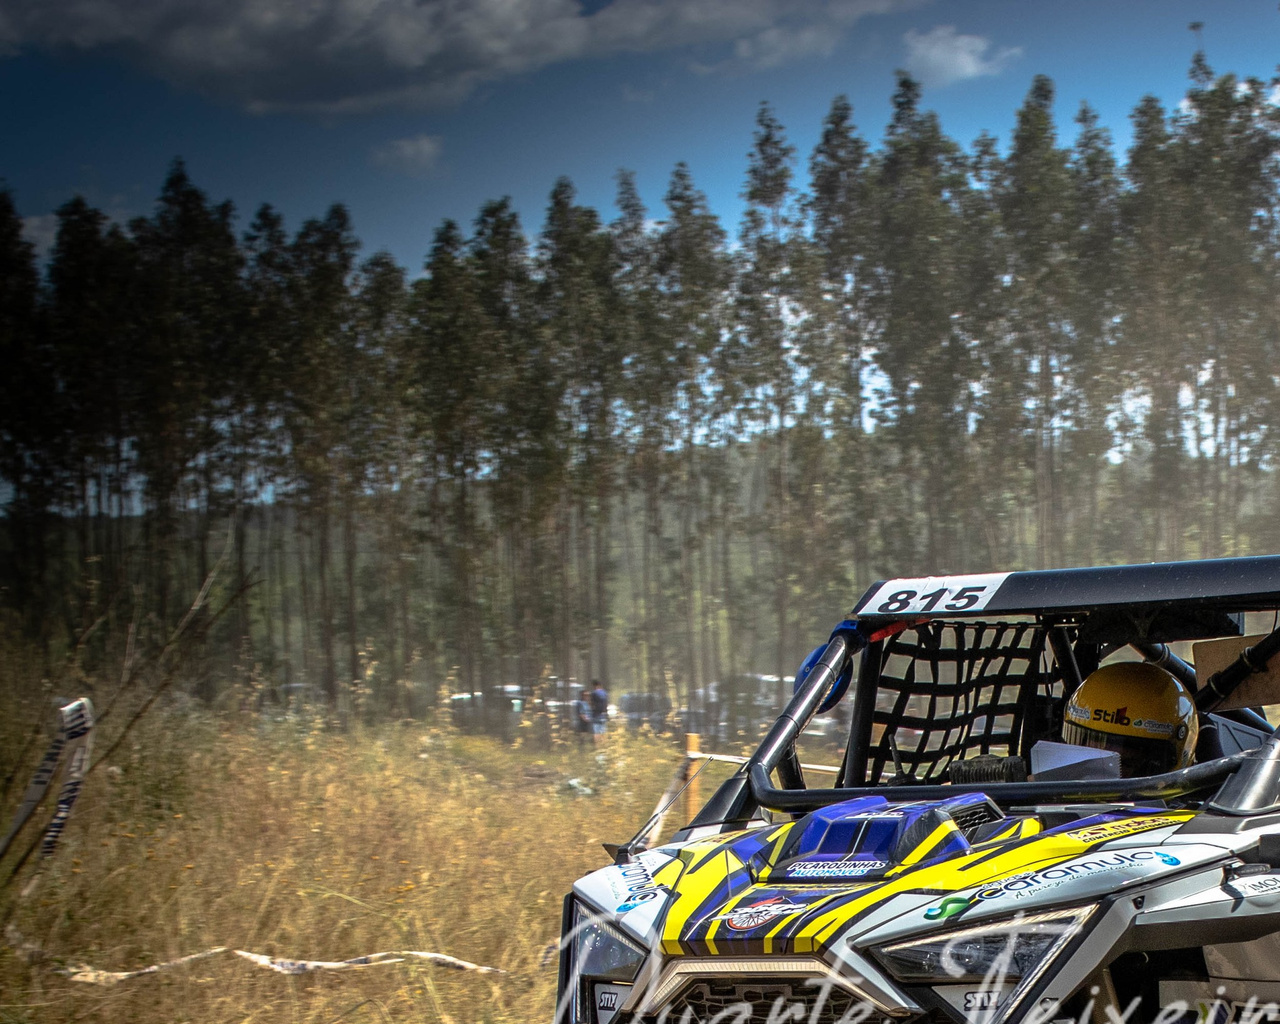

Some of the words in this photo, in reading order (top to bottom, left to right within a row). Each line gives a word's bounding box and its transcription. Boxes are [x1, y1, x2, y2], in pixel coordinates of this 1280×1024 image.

[877, 585, 987, 613] 815
[1092, 706, 1131, 726] Stilo
[787, 860, 887, 871] PICARODINHAS
[599, 992, 618, 1009] STIX
[963, 991, 1001, 1009] STIX
